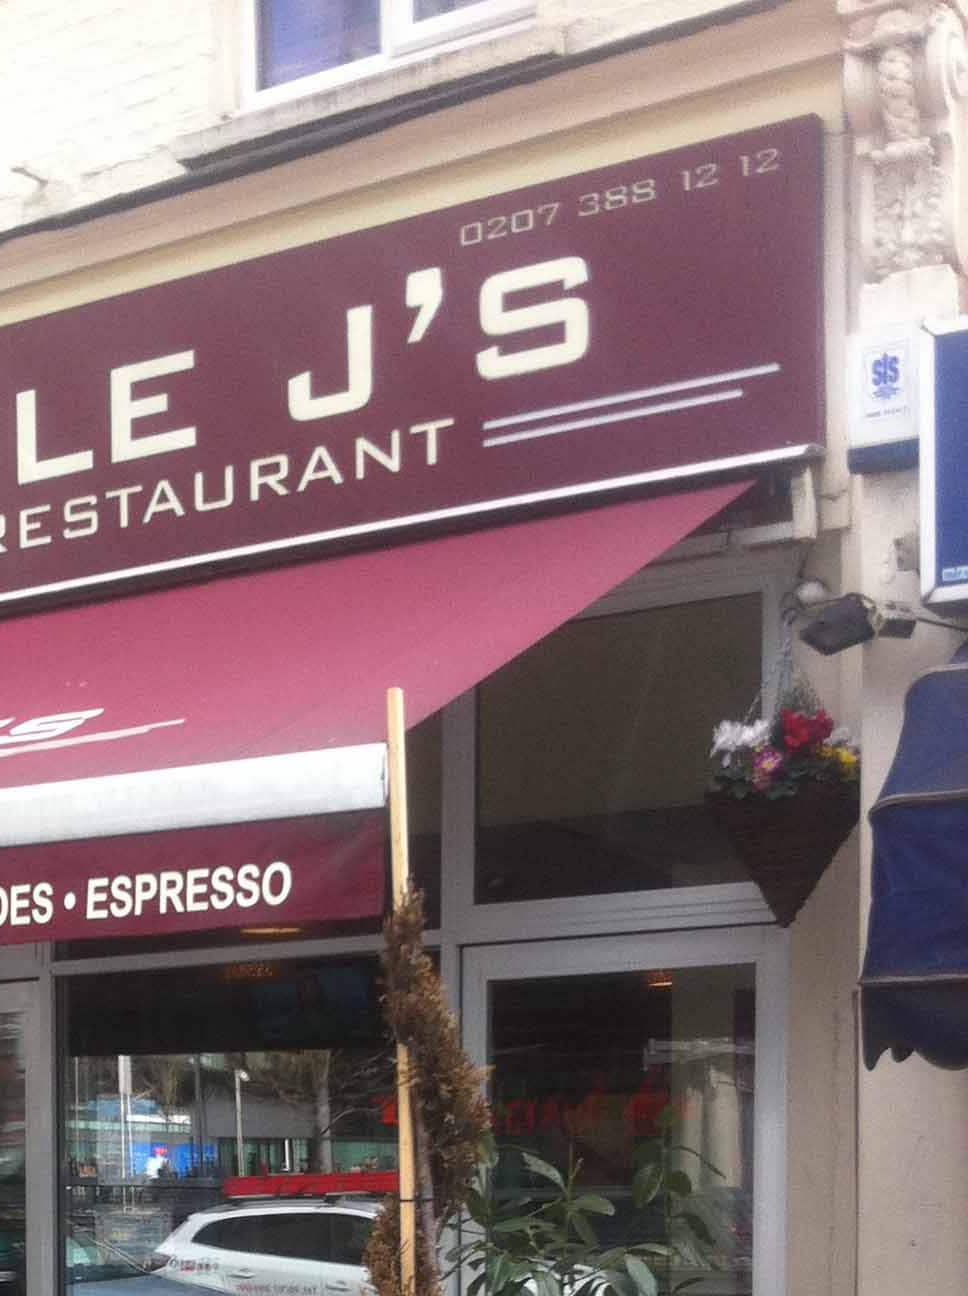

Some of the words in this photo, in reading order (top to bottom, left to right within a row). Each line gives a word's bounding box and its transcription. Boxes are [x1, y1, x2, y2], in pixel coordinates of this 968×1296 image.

[459, 202, 560, 247] 0207
[577, 179, 658, 218] 388
[680, 163, 719, 192] 12
[738, 147, 780, 177] 12
[287, 256, 590, 422] J'S
[84, 861, 293, 920] ESPRESSO
